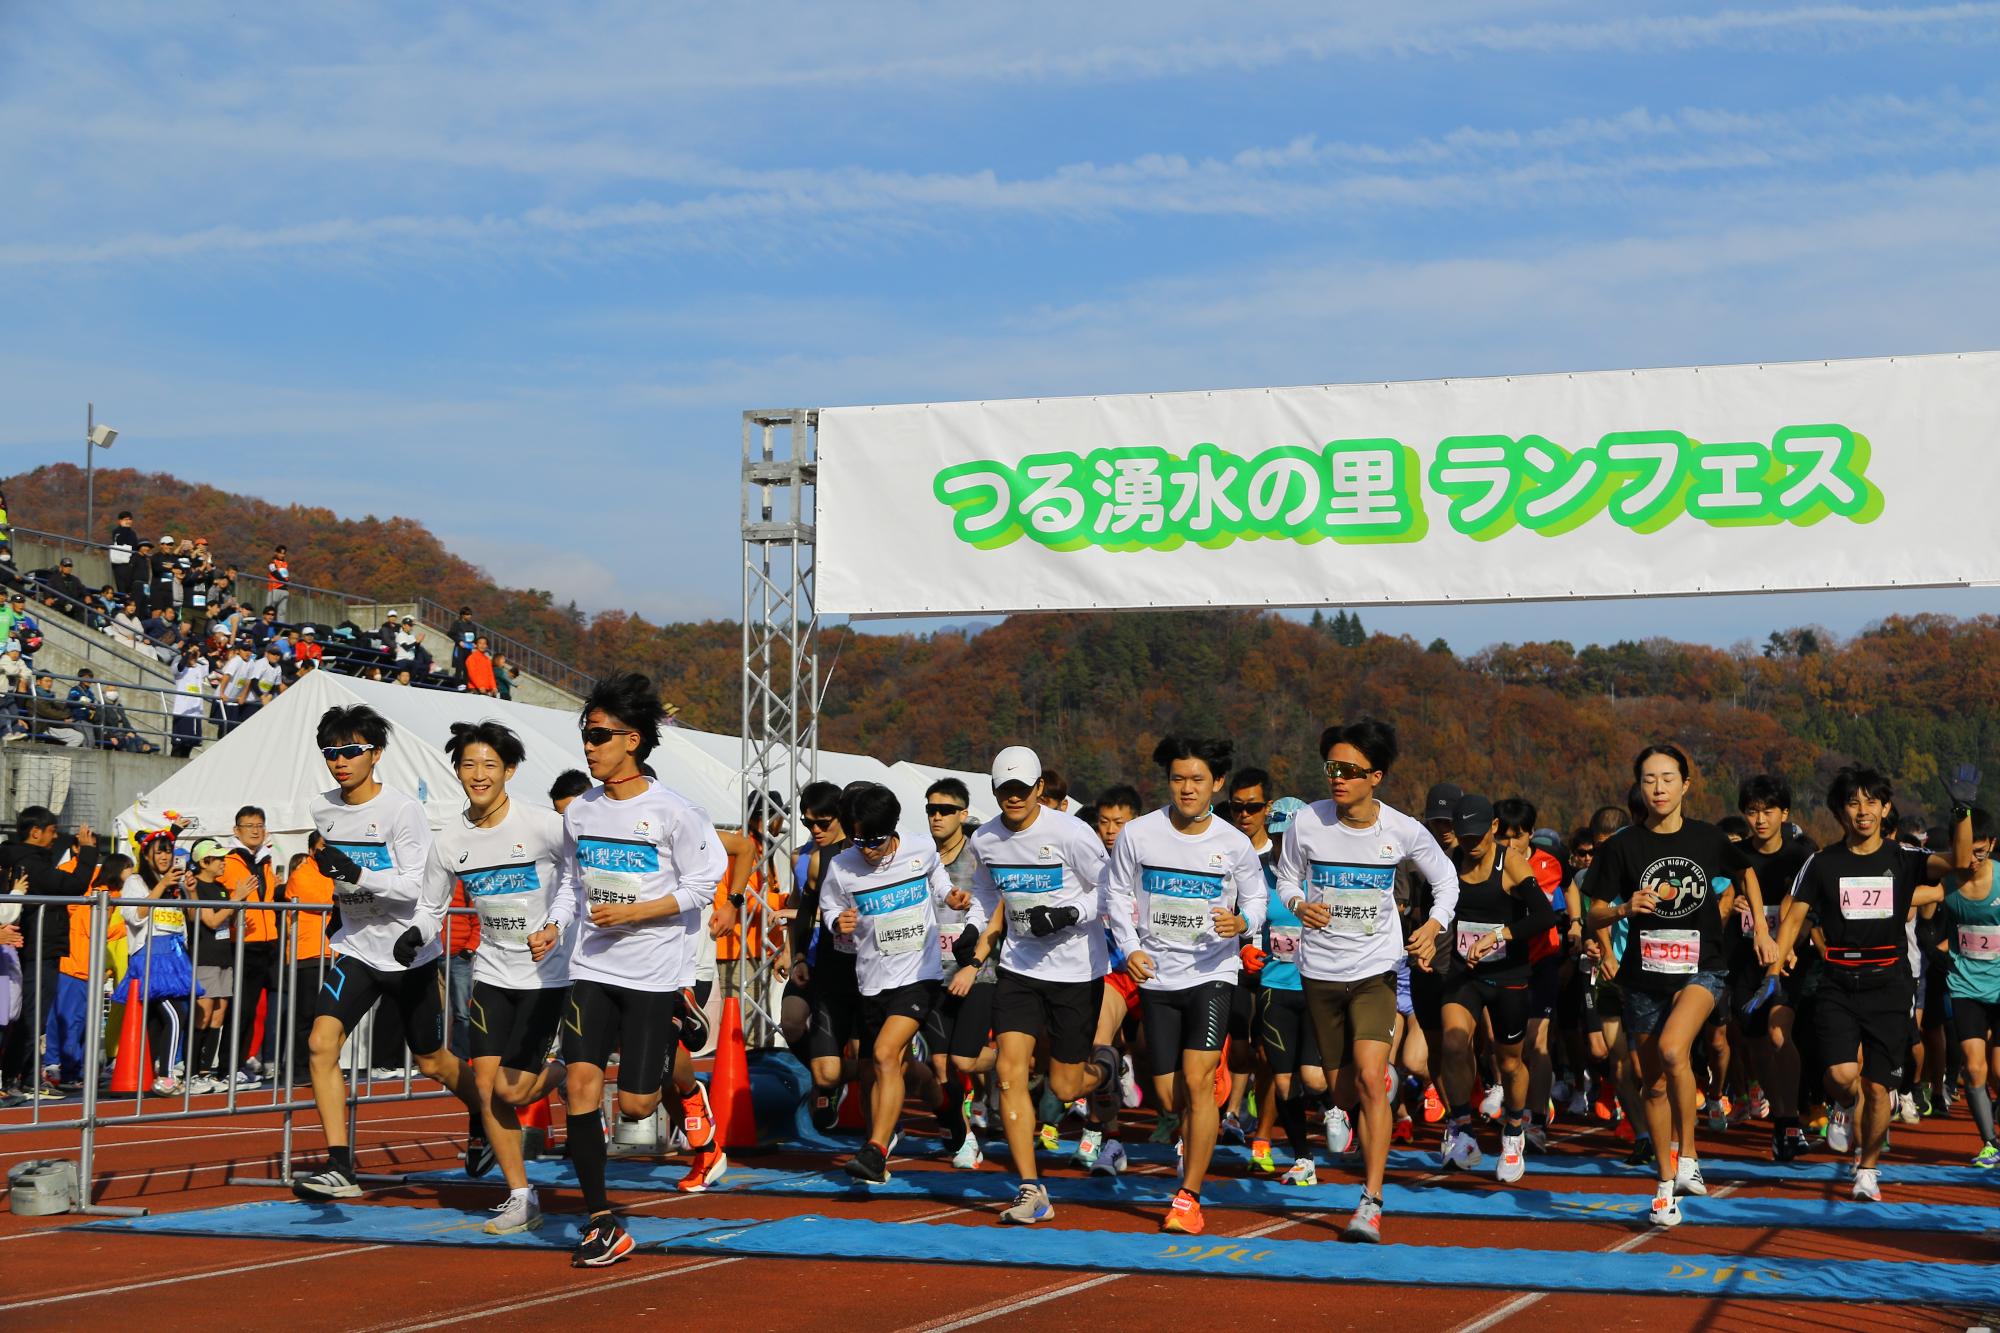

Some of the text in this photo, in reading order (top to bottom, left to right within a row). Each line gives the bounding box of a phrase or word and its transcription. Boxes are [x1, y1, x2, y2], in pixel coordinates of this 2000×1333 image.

[938, 429, 1868, 540] つる湧水の里 ランフェス
[581, 846, 645, 868] 山梨学院
[1643, 860, 1666, 882] SATURDAY
[1667, 859, 1689, 868] NIGHT
[994, 873, 1052, 889] 山梨学院
[1150, 875, 1216, 896] 山梨学院
[1319, 871, 1390, 888] 山梨学院
[864, 884, 924, 912] 山梨学院
[1843, 890, 1881, 906] A 27
[1152, 912, 1204, 929] 山梨学院大学
[1744, 915, 1750, 928] A
[879, 924, 925, 943] 山梨学院大学
[1460, 934, 1467, 948] A
[1961, 934, 1989, 949] A 2
[1273, 937, 1280, 951] A
[1643, 942, 1690, 960] A 501
